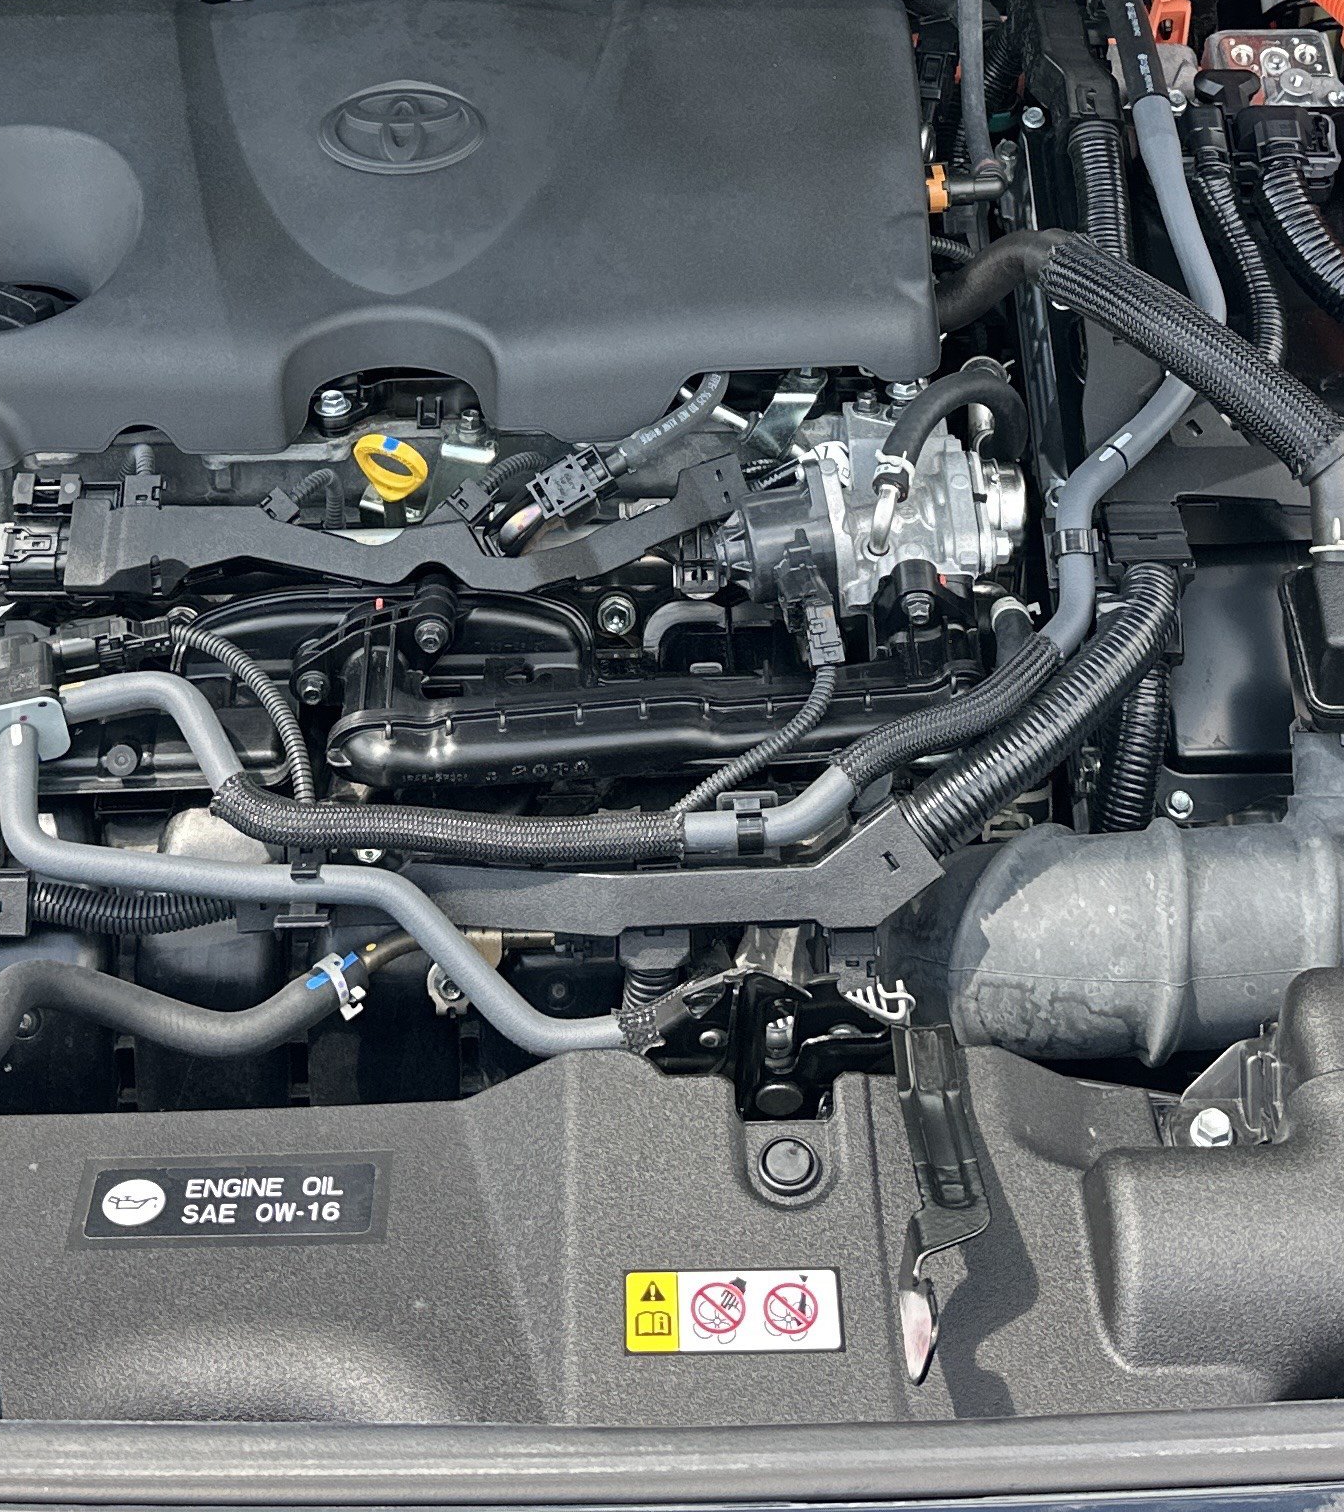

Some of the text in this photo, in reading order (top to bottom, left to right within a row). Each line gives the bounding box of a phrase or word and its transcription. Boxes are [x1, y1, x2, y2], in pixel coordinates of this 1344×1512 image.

[185, 1176, 344, 1199] ENGINE OIL
[181, 1201, 341, 1224] SAE 0W-16
